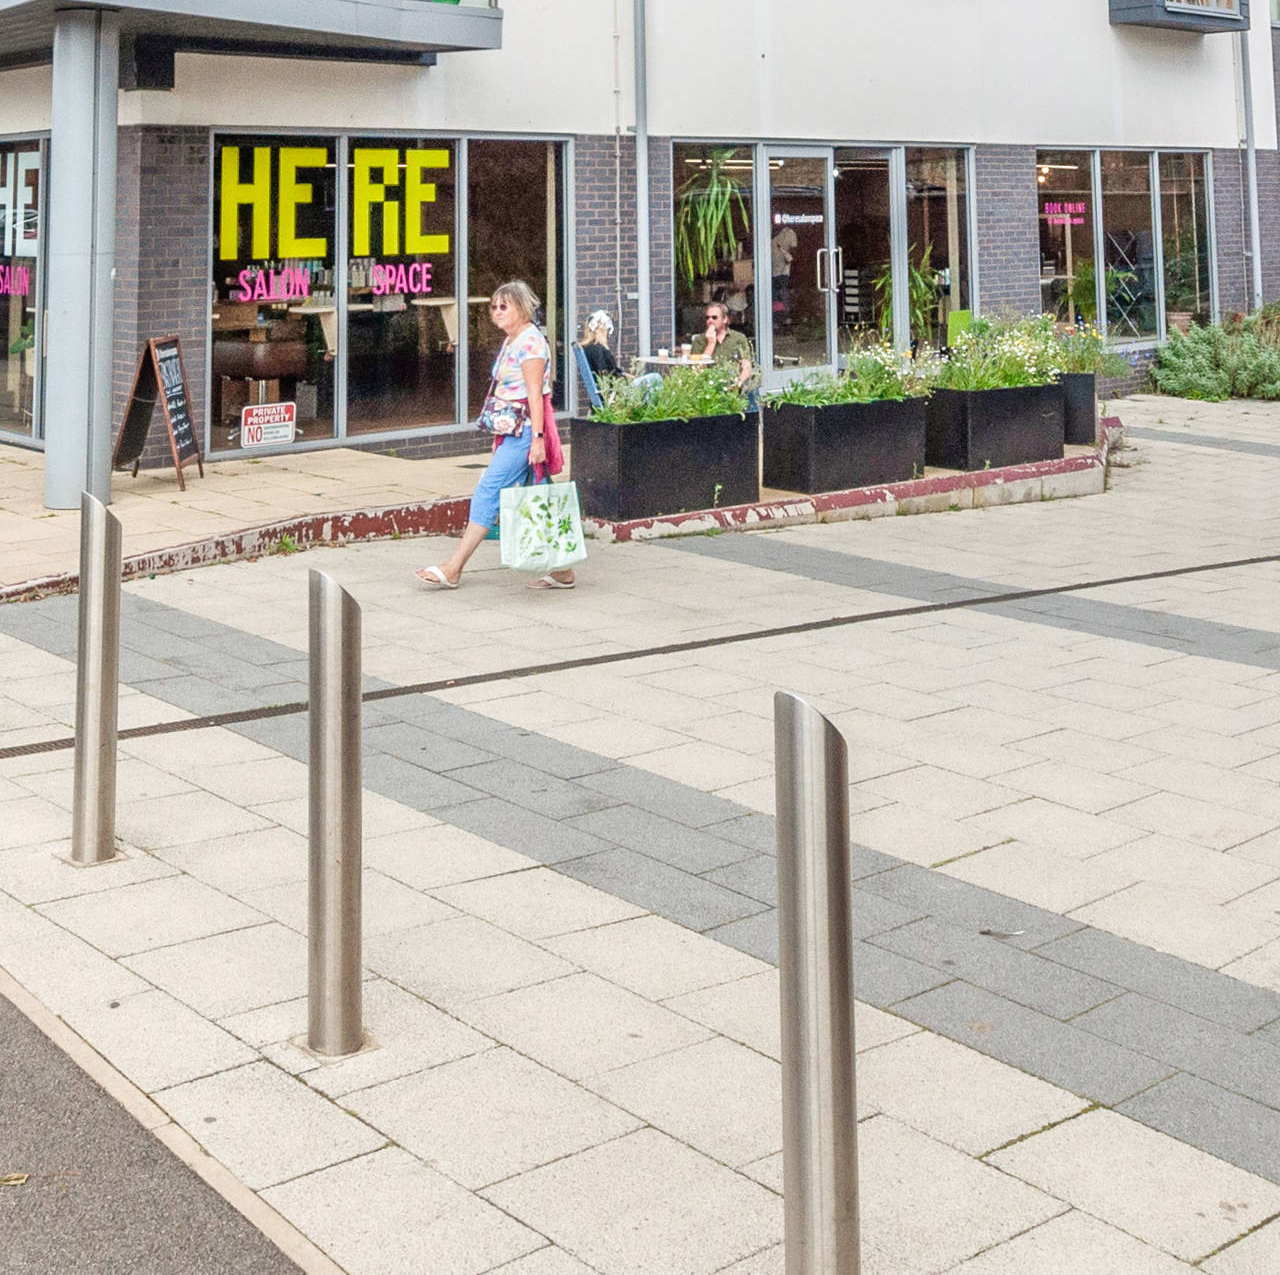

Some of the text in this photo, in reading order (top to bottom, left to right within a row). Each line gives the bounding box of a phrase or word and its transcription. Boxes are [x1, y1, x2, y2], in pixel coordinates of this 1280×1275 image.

[1045, 202, 1086, 213] BOOK ONLINE
[238, 263, 432, 301] SALON SPACE
[253, 406, 286, 416] PRIVATE
[247, 414, 290, 425] PROPERTY
[247, 426, 263, 443] NO
